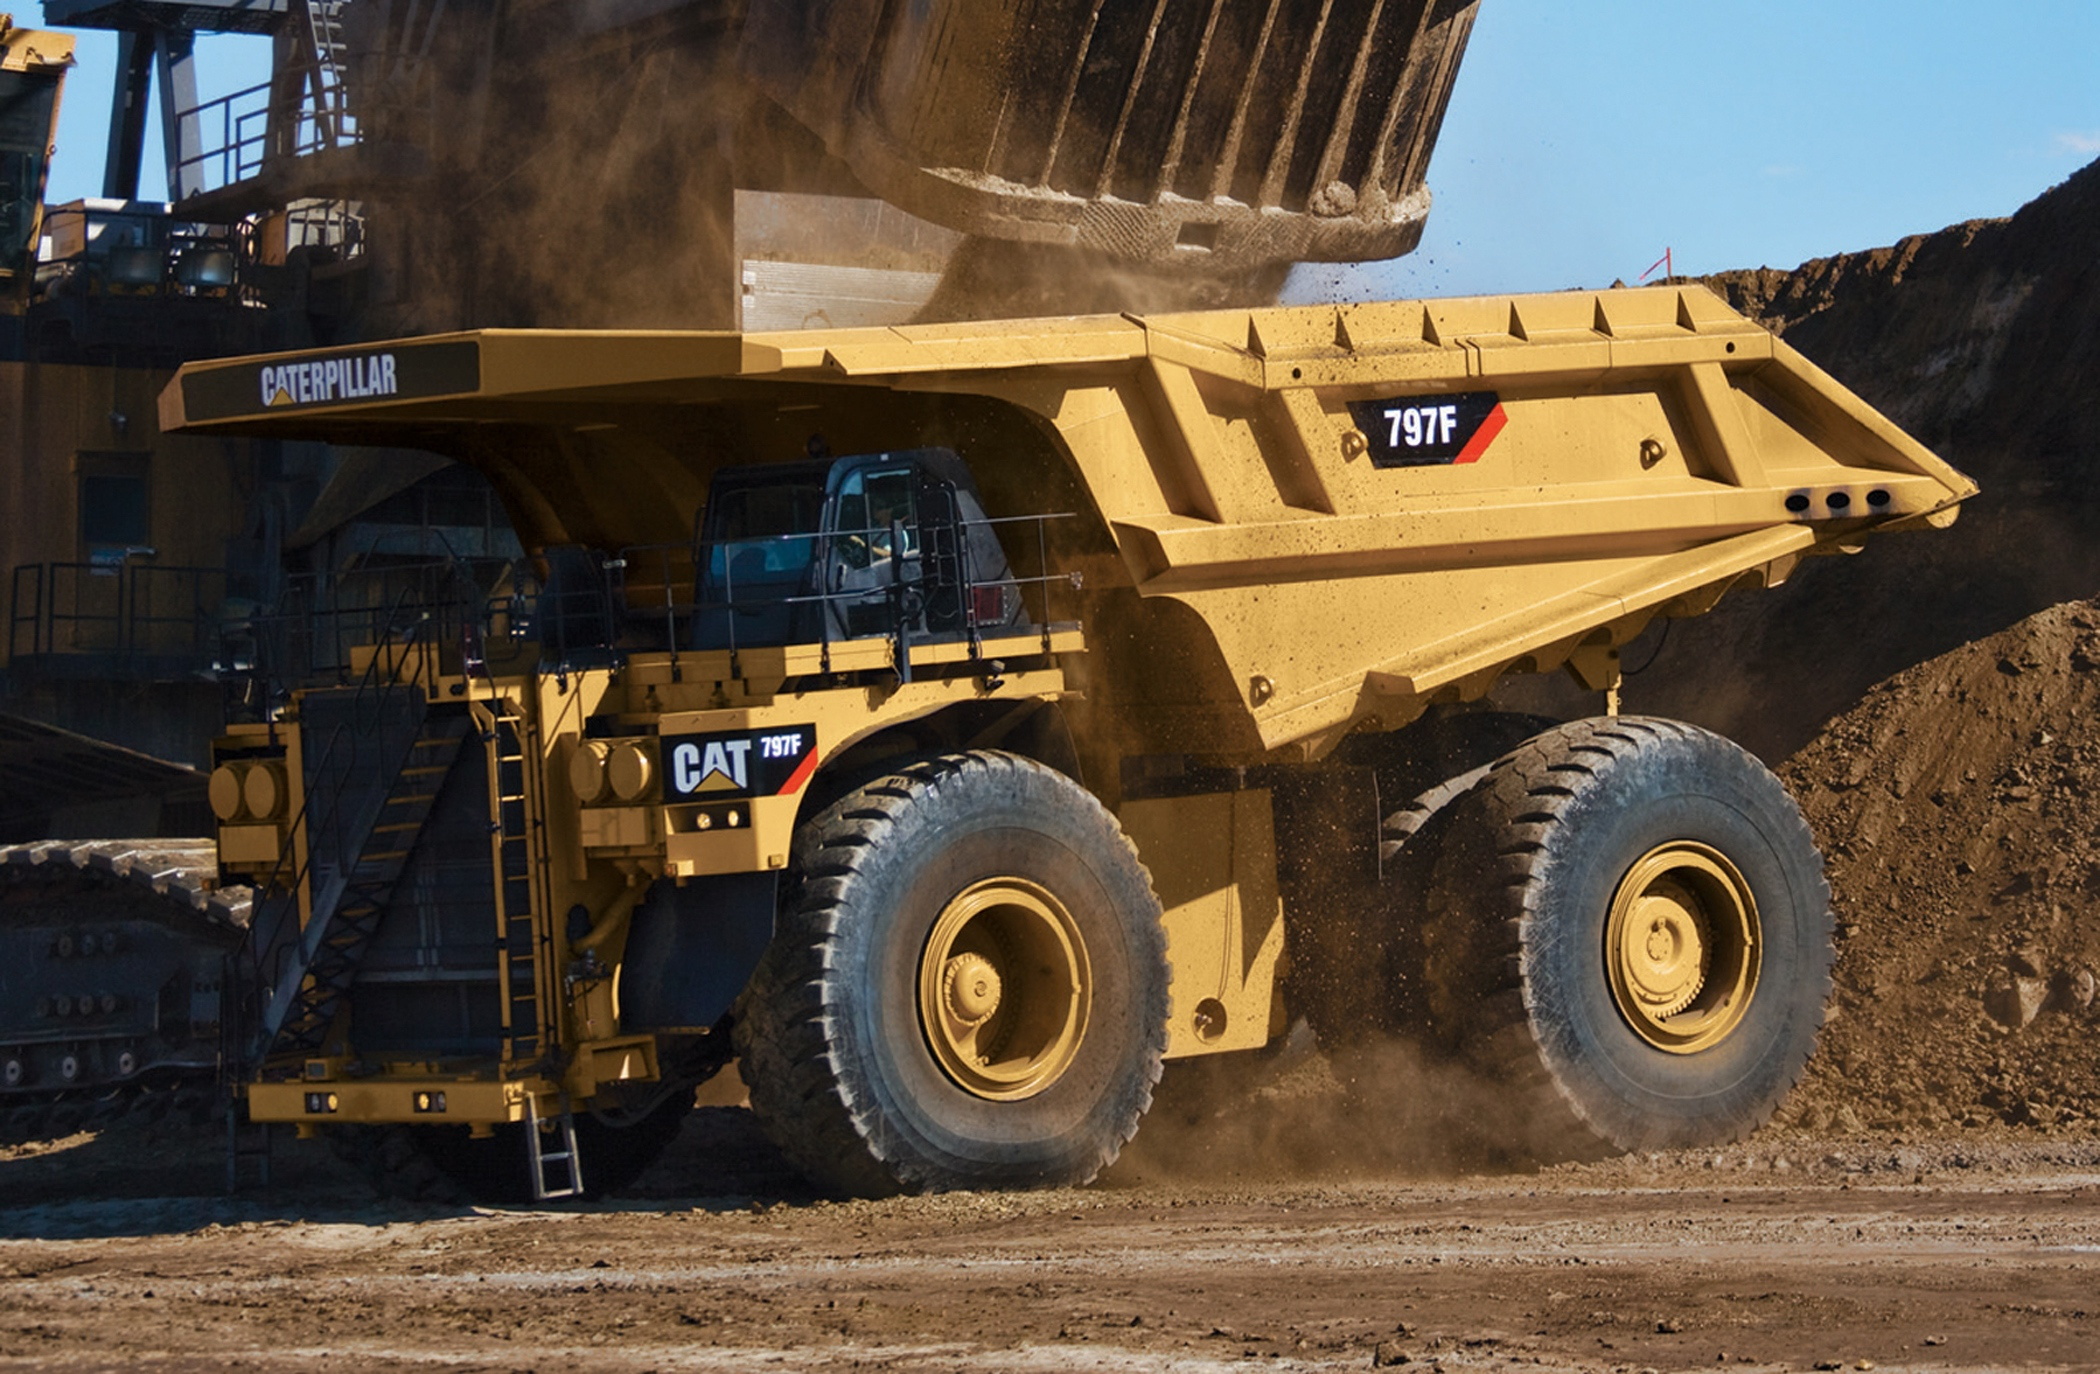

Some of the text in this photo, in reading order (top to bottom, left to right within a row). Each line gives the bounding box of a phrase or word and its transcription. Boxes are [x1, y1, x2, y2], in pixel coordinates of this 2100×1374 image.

[261, 354, 397, 406] CATERPILLAR
[1383, 405, 1457, 447] 797F
[673, 733, 802, 793] CAT 797F
